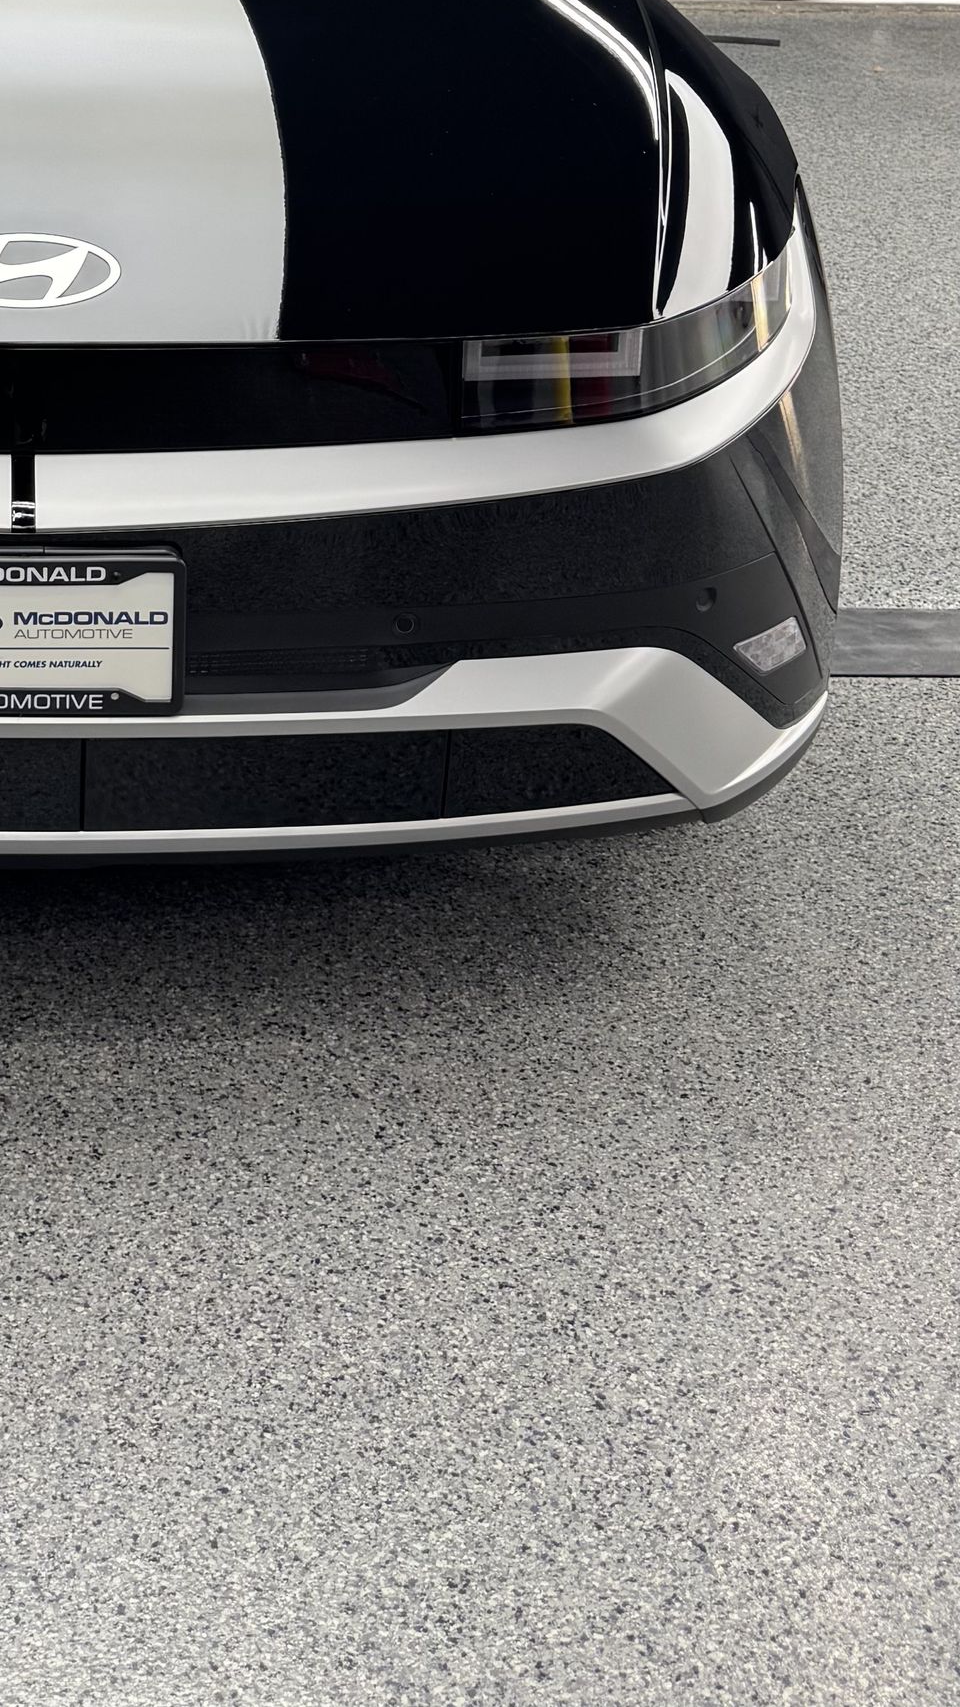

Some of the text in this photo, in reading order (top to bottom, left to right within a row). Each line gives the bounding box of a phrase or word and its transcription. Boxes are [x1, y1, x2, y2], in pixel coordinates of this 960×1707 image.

[13, 611, 169, 625] McDONALD
[14, 628, 133, 639] AUTOMOTIVE
[13, 660, 47, 668] COMES
[49, 660, 103, 668] NATURALLY
